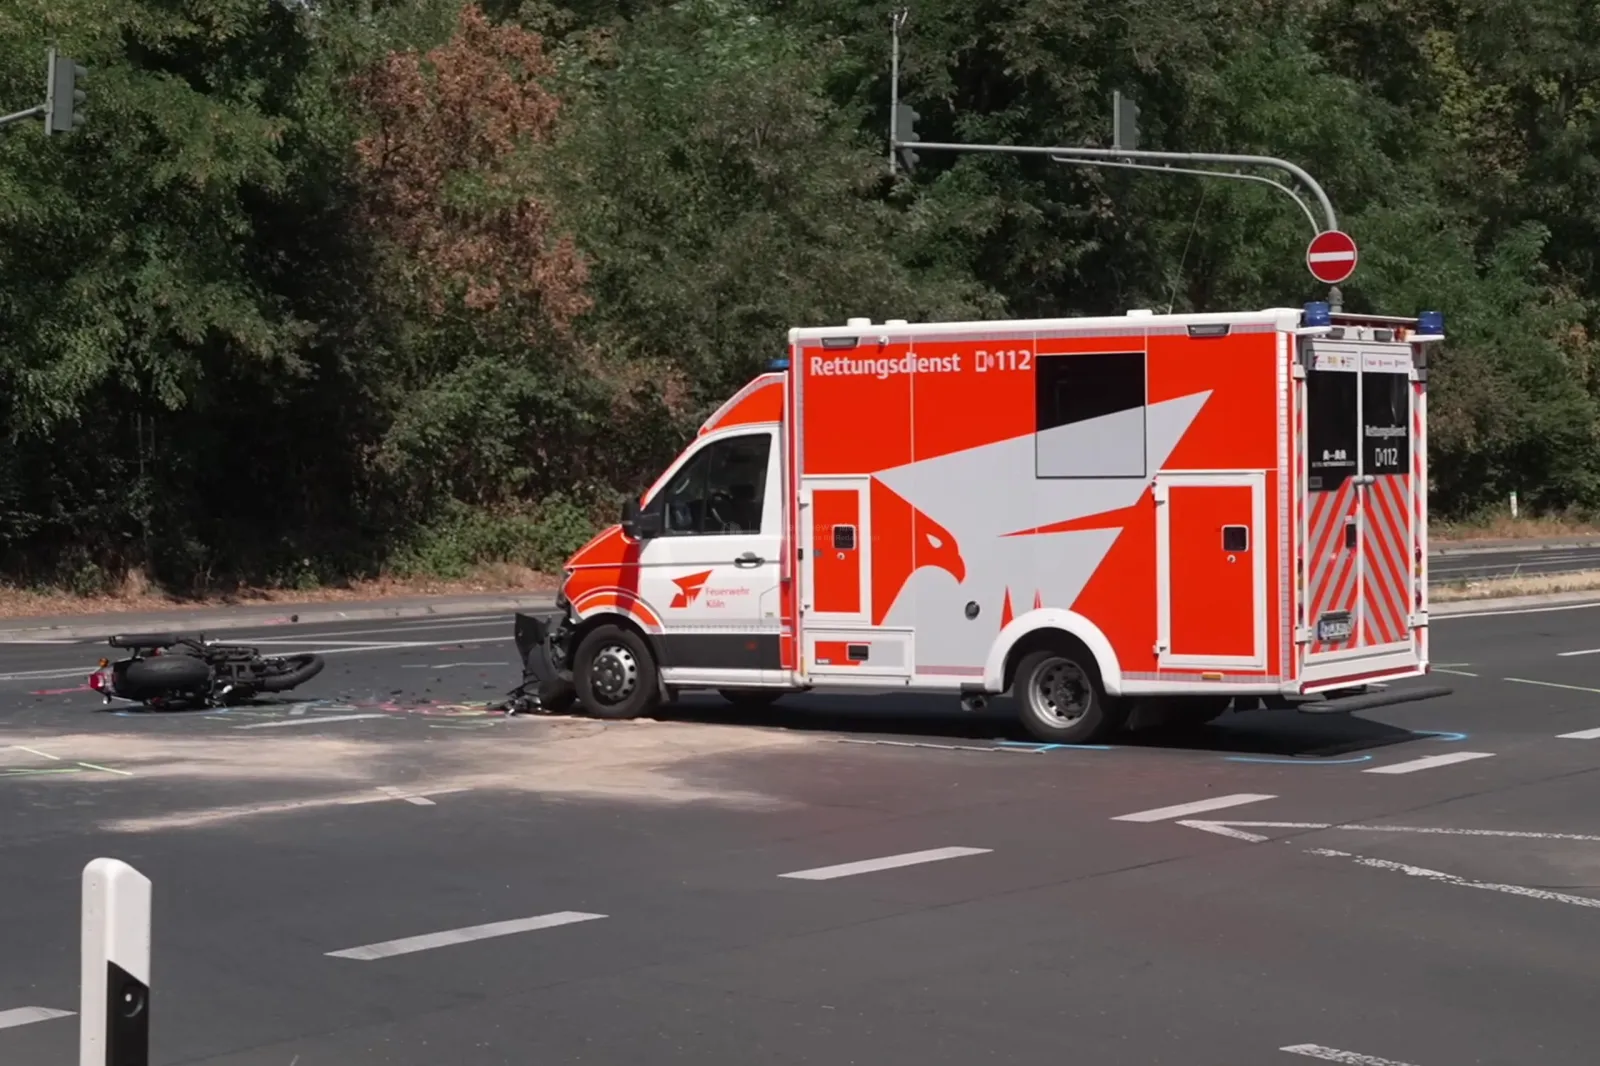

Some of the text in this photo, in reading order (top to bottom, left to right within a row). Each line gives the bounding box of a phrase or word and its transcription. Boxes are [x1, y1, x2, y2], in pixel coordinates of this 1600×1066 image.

[810, 350, 1032, 380] Rettungsdienst 112
[1383, 448, 1398, 466] 112
[705, 586, 750, 596] Feuerwehr
[706, 599, 725, 608] Köln
